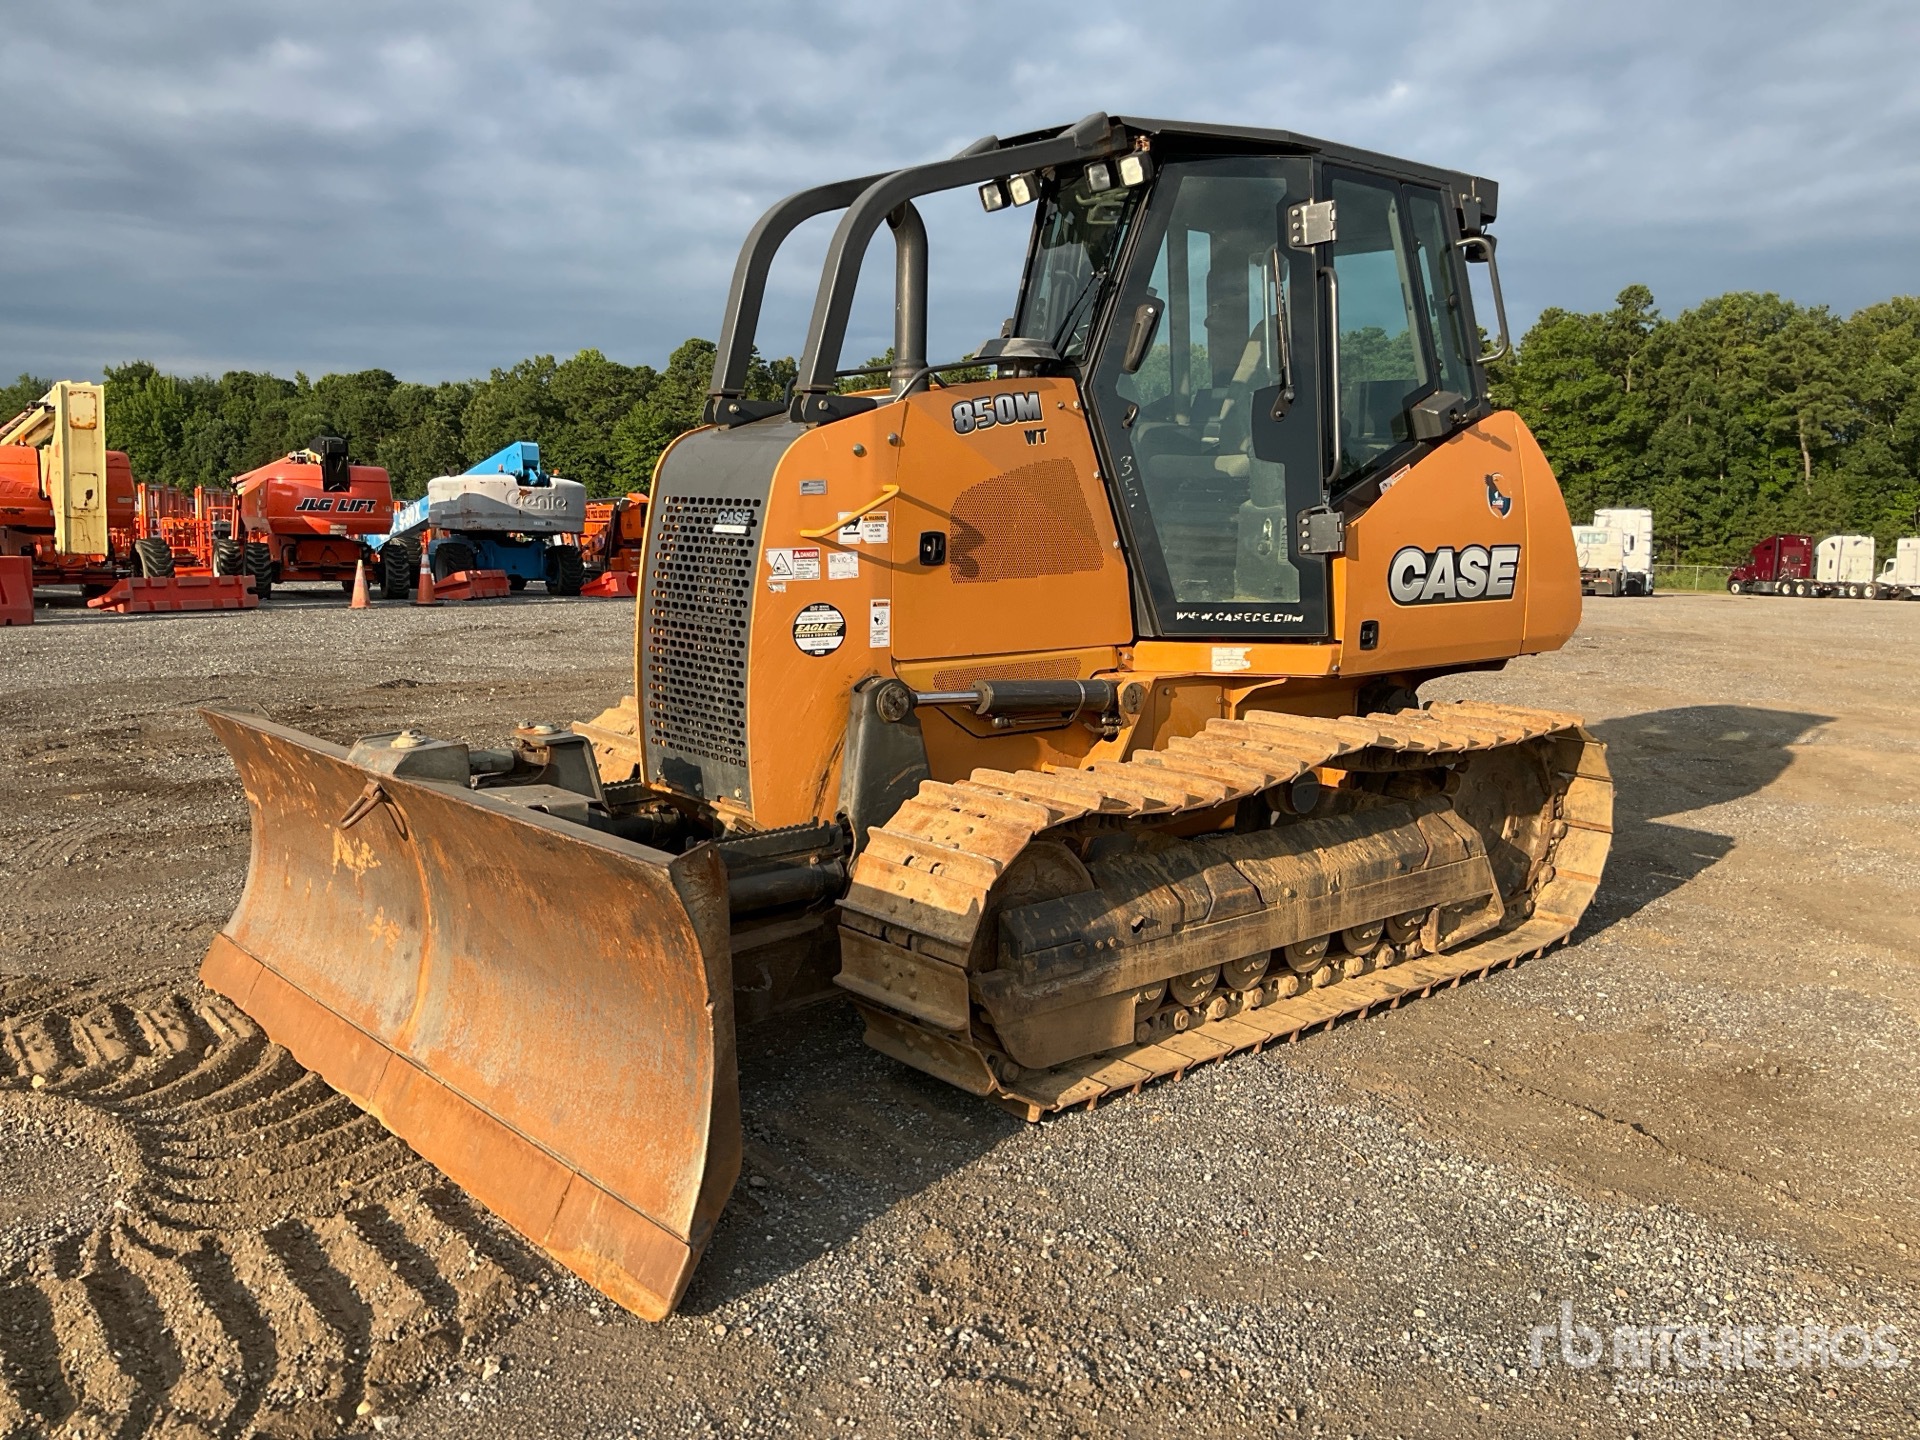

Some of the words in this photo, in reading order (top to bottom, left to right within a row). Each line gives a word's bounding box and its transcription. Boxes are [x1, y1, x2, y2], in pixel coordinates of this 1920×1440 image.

[951, 391, 1043, 434] 850M
[1024, 428, 1047, 446] WT
[295, 498, 334, 512] JLG
[336, 499, 377, 513] LIFT
[506, 489, 567, 511] Genie
[716, 511, 751, 525] CASE
[1388, 546, 1521, 604] CASE
[796, 624, 835, 632] EAGLE
